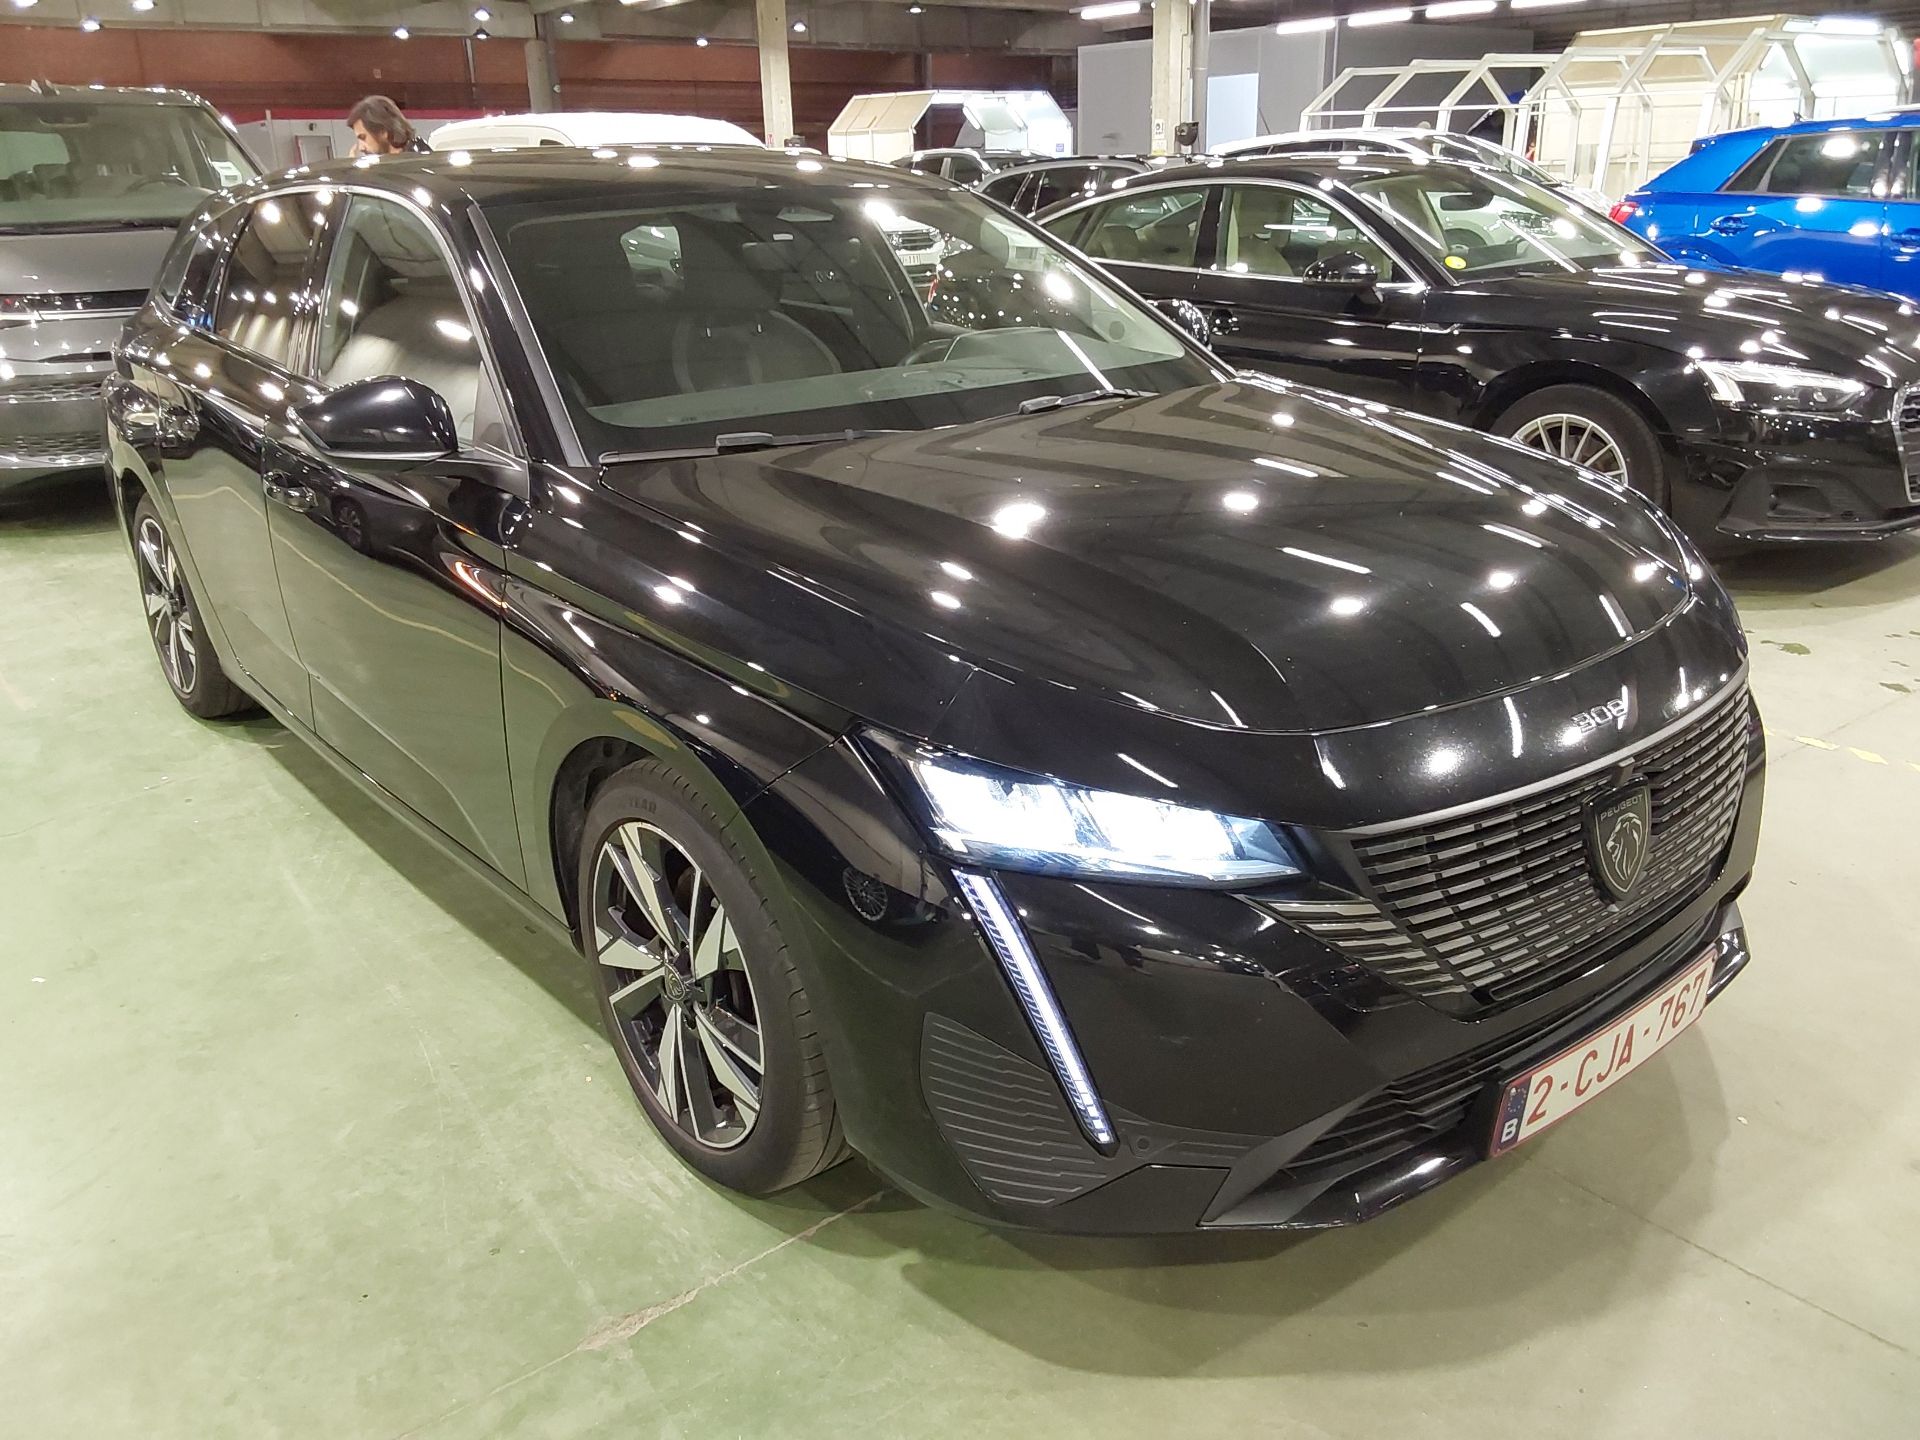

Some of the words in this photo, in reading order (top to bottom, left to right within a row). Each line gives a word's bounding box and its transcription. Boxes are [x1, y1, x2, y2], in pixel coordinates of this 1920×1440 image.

[1571, 699, 1628, 733] 308
[1600, 794, 1643, 821] PEUGEOT
[1526, 967, 1708, 1126] 2-CJA-767
[1501, 1118, 1518, 1143] B
